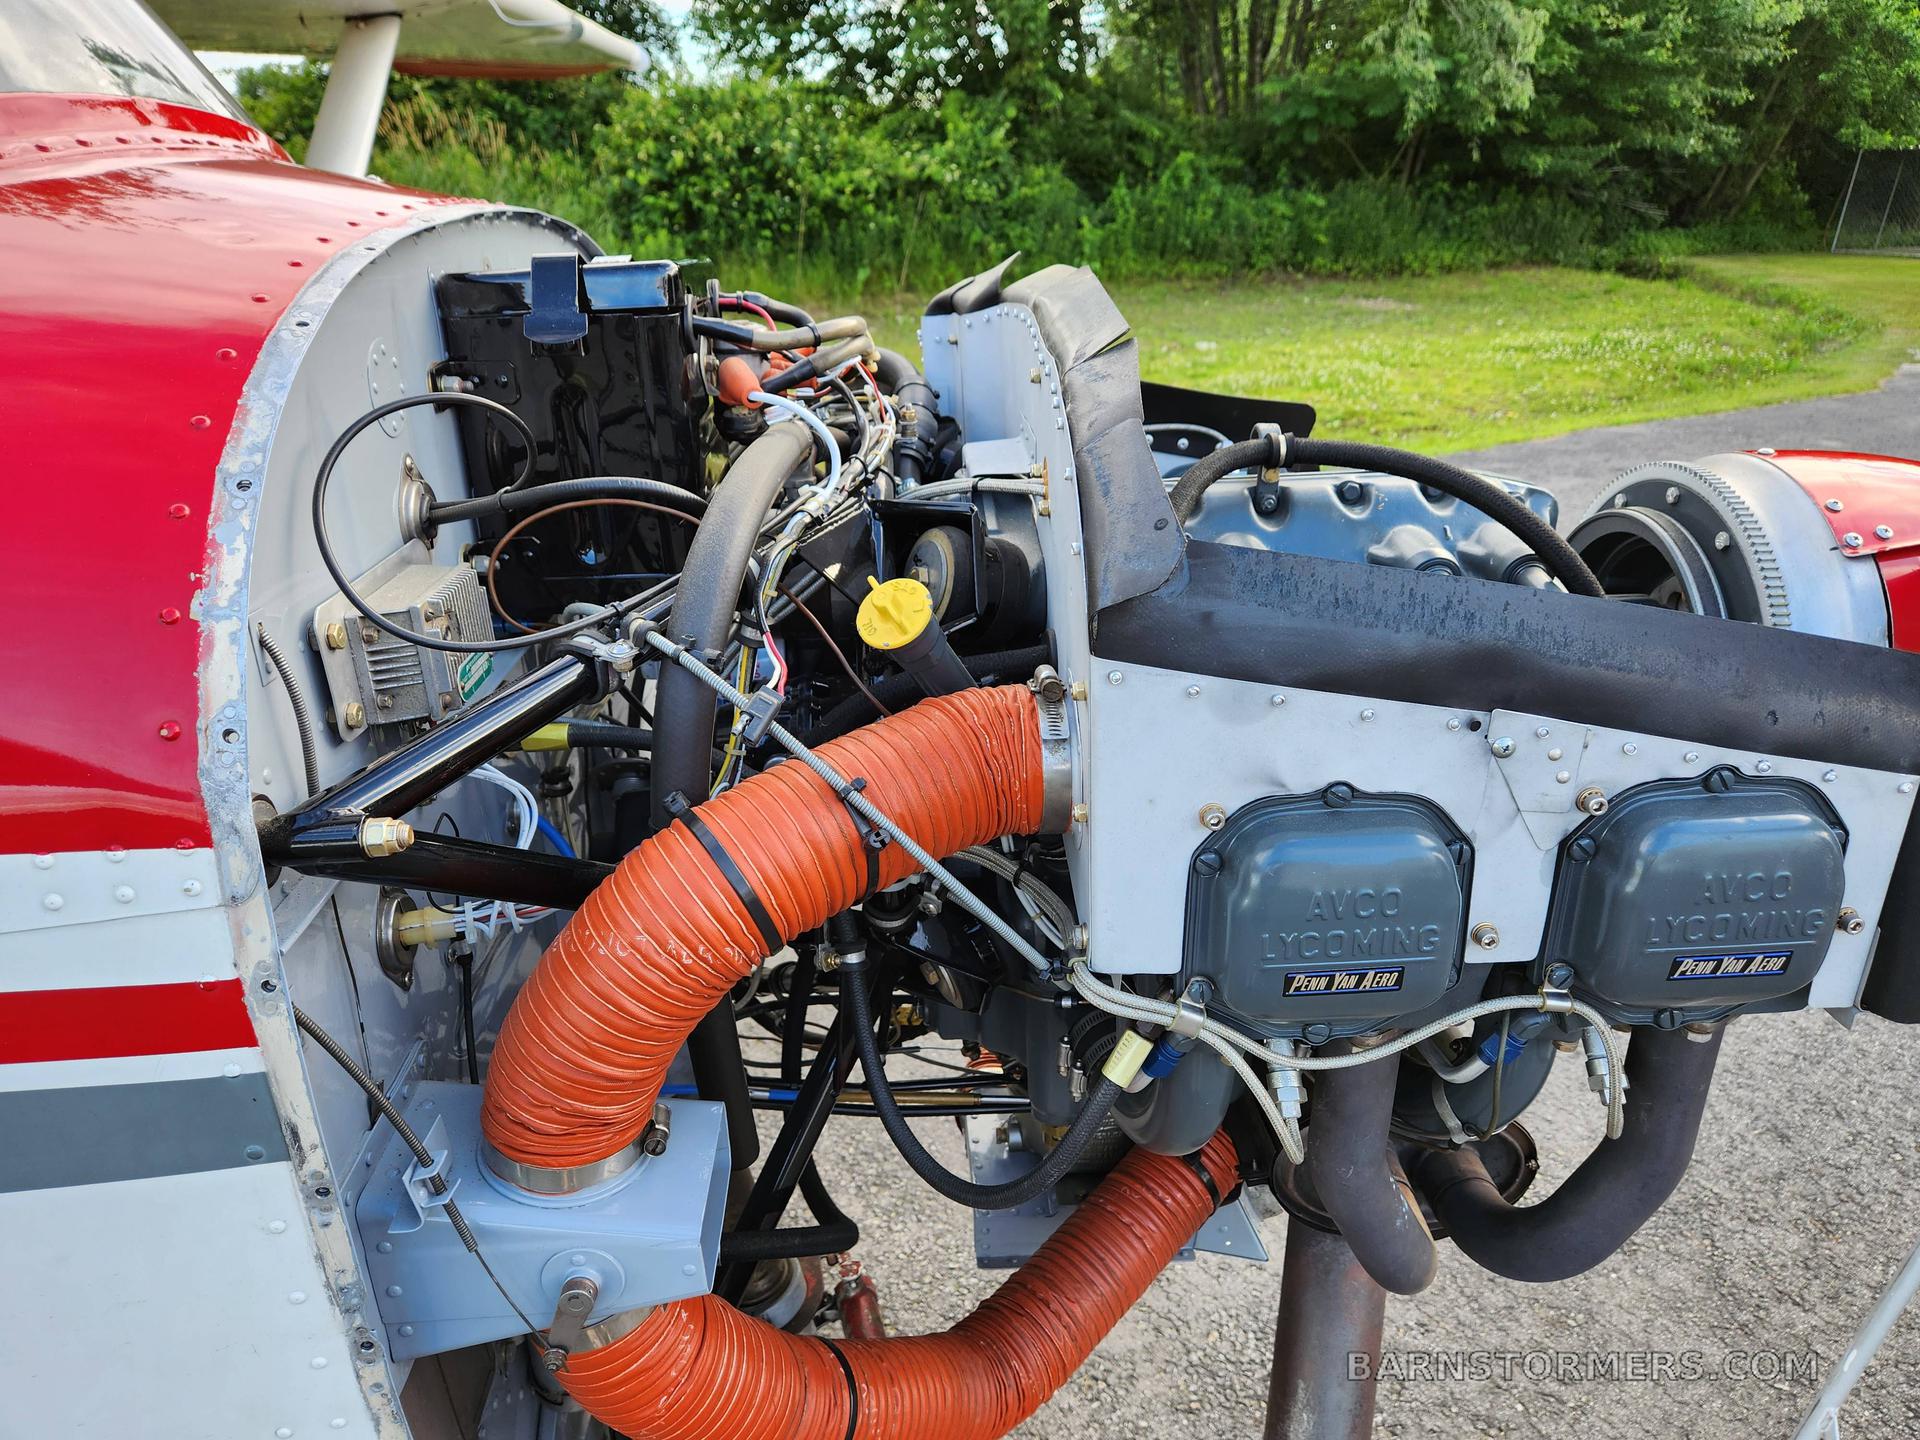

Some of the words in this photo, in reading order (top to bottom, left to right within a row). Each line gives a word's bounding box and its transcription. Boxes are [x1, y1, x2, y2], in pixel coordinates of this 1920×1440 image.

[1305, 886, 1403, 922] AVCO
[1694, 870, 1793, 906] AVCO
[1260, 923, 1441, 961] LYCOMING
[1648, 907, 1826, 945] LYCOMING
[1287, 974, 1328, 994] PENN
[1331, 972, 1360, 991] YAN
[1360, 970, 1399, 989] AERO
[1673, 958, 1716, 978] PENN
[1718, 956, 1745, 976] YAN
[1746, 954, 1787, 973] AERO
